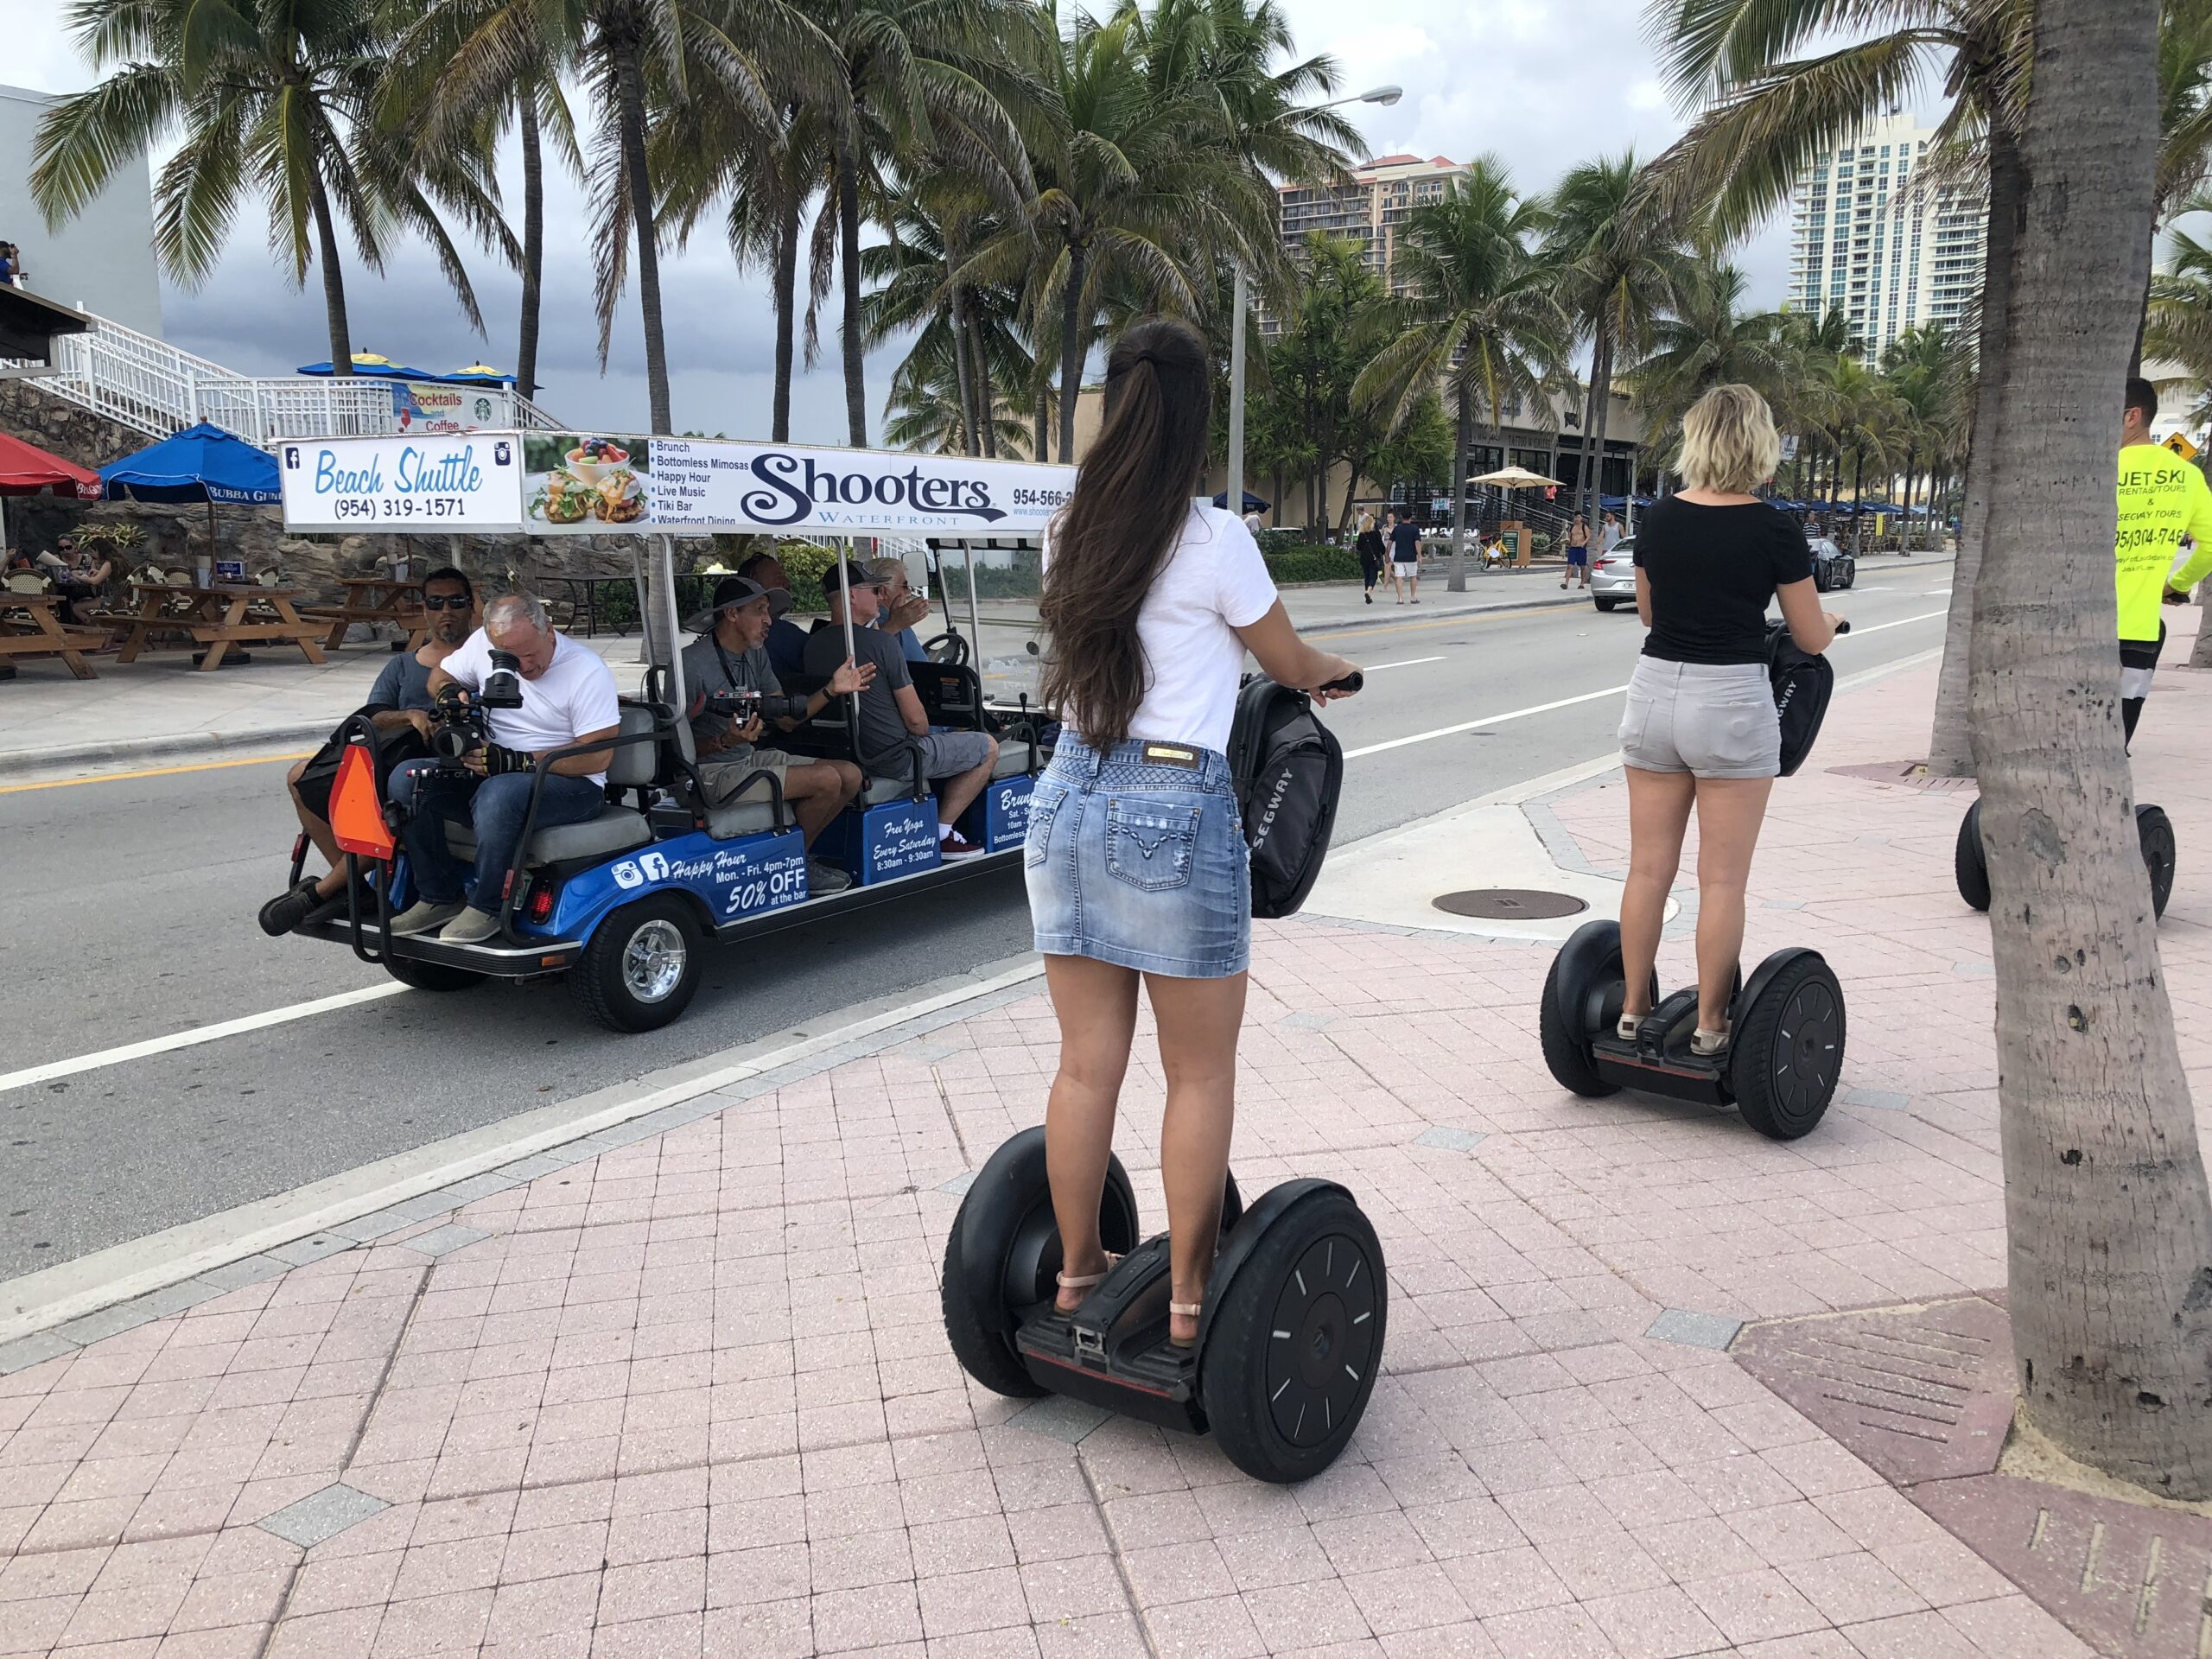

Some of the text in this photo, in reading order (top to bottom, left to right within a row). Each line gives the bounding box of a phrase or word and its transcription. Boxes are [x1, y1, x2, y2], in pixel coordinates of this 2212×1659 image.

[410, 392, 462, 406] Cocktails
[426, 420, 459, 431] Coffee
[657, 441, 690, 453] Brunch
[315, 444, 483, 495] Beach Shuttle
[657, 455, 749, 470] Bottomless Mimosas
[658, 470, 711, 484] Happy Hour
[2118, 469, 2185, 486] JET SKI
[209, 486, 250, 500] BUBBA
[658, 486, 706, 497] Live Music
[741, 453, 1008, 525] Shooters
[334, 498, 466, 520] (954) 319-1571
[658, 500, 693, 511] Tiki Bar
[658, 515, 705, 524] Waterfront
[817, 511, 961, 526] WATERFRONT
[2155, 510, 2182, 518] TOURS
[1253, 767, 1293, 850] SEGWAY
[884, 817, 924, 839] Free Yoga
[1007, 821, 1022, 830] 10am
[994, 830, 1026, 844] Bottomless
[873, 835, 936, 860] Every Saturday
[671, 850, 747, 880] Happy Hour
[877, 858, 903, 871] 8:30am
[908, 850, 933, 863] 9:30am
[715, 871, 739, 884] Mon.
[747, 865, 762, 877] Fri.
[764, 856, 804, 874] 4pm-7pm
[726, 868, 805, 914] 50% OFF
[770, 890, 806, 906] at the bar
